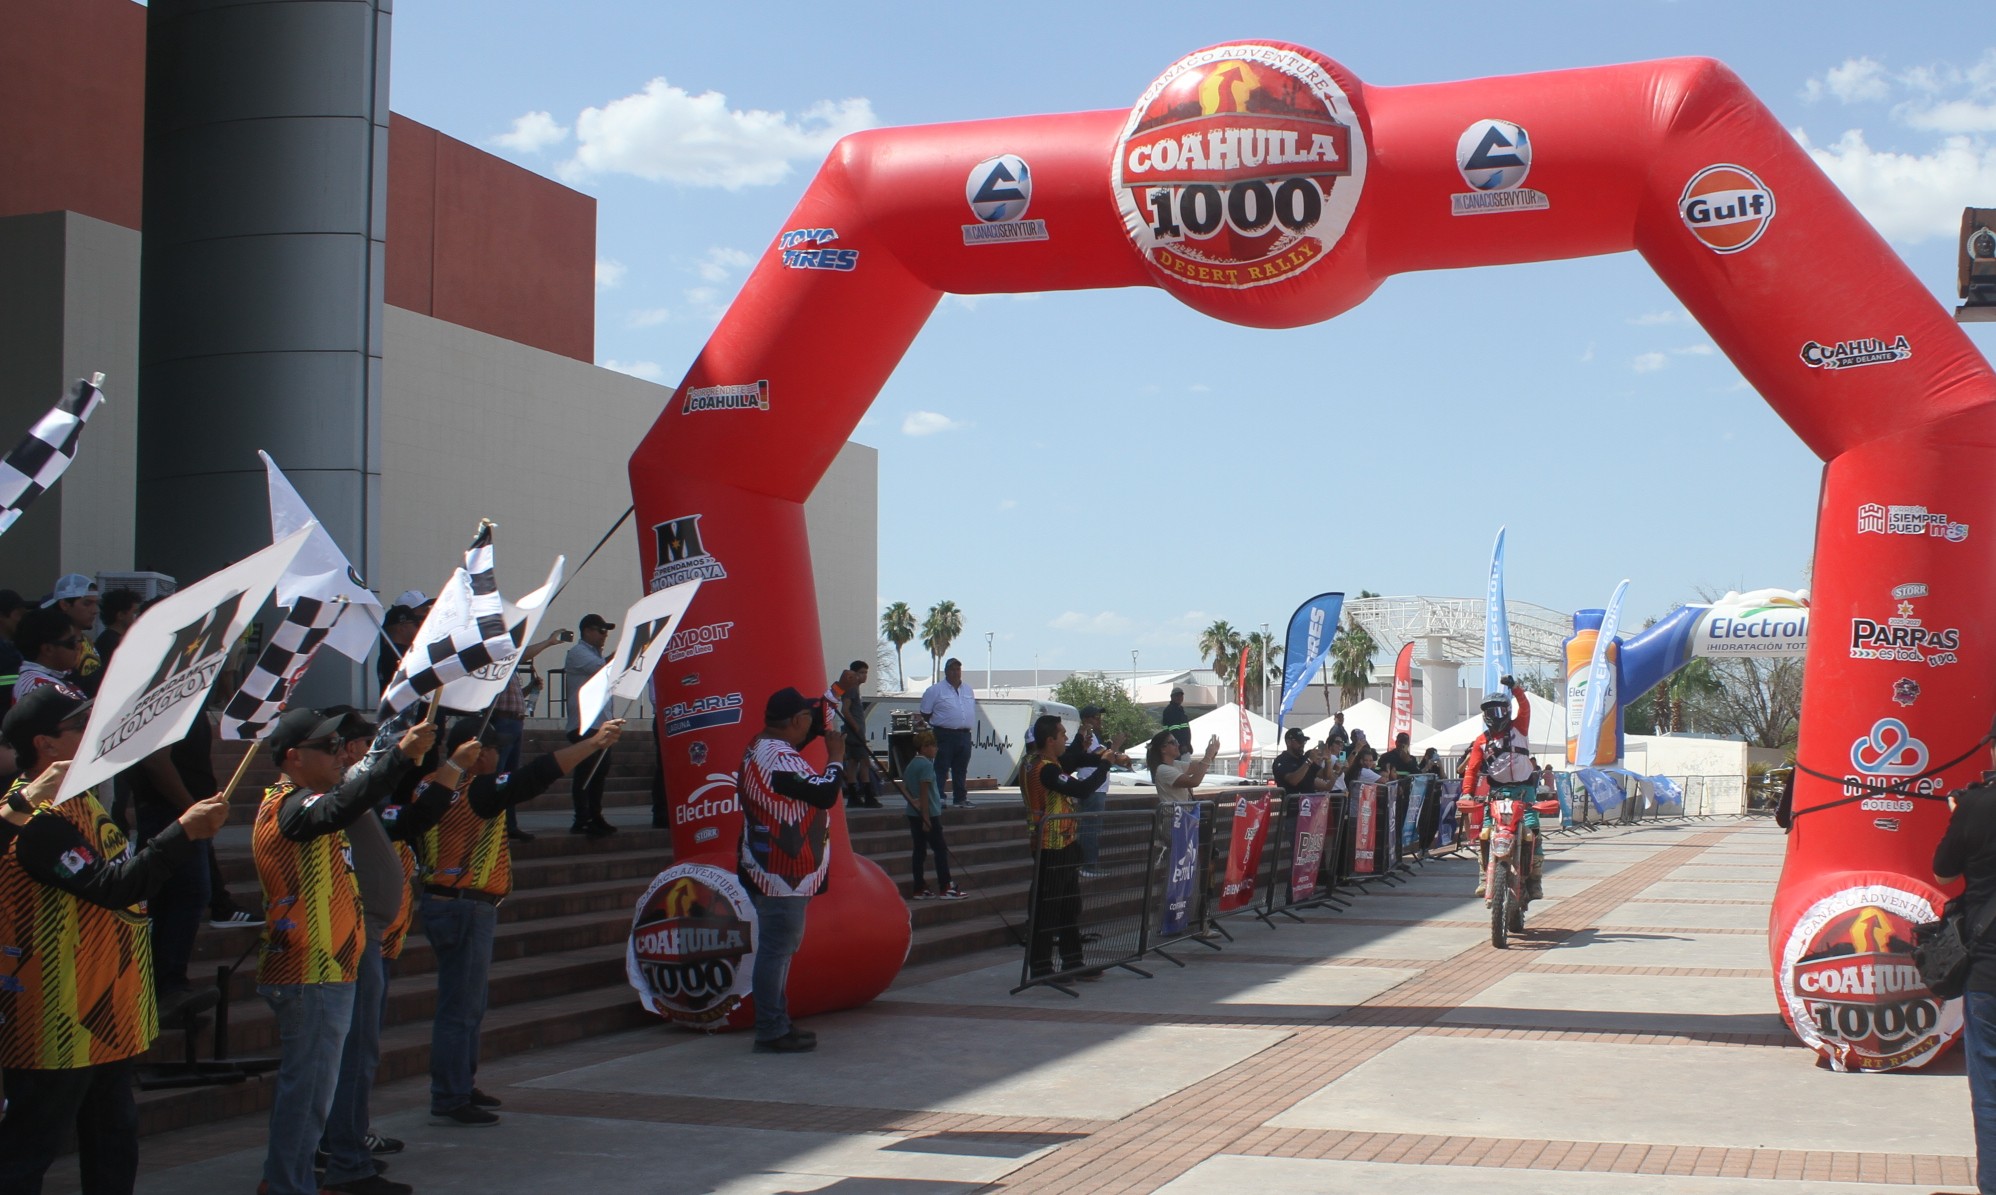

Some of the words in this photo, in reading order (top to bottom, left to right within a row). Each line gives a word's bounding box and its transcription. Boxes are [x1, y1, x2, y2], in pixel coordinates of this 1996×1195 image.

[1144, 52, 1215, 102] CANACO
[1222, 48, 1331, 91] ADVENTURE
[1128, 127, 1339, 172] COAHUILA
[1150, 178, 1322, 241] 1000
[1463, 189, 1537, 209] CANACOSERVYTUR
[1686, 194, 1765, 224] Gulf
[971, 222, 1038, 239] CANACOSERVYTUR
[784, 249, 857, 270] TIRES
[1160, 250, 1238, 283] DESERT
[1250, 244, 1315, 280] RALLY
[1856, 352, 1893, 364] DELANTE
[1889, 513, 1946, 524] ¡SIEMPRE
[1889, 523, 1926, 533] PUED
[651, 563, 725, 592] MONCLOVA
[659, 557, 705, 576] PRENDAMOS
[1894, 585, 1927, 597] STORR
[664, 623, 731, 650] AYDOIT
[1708, 616, 1810, 639] Electrol
[1852, 619, 1959, 650] PARRAS
[1879, 650, 1894, 659] es
[133, 660, 210, 714] PRENDAM
[90, 658, 224, 764] MONCLOV
[664, 694, 742, 719] POLARIS
[675, 793, 744, 825] Electrol
[679, 866, 739, 899] ADVENTURE
[635, 927, 744, 955] COAHUILA
[643, 959, 733, 995] 1000
[1799, 964, 1928, 995] COAHUIL
[1814, 1000, 1937, 1037] 1000
